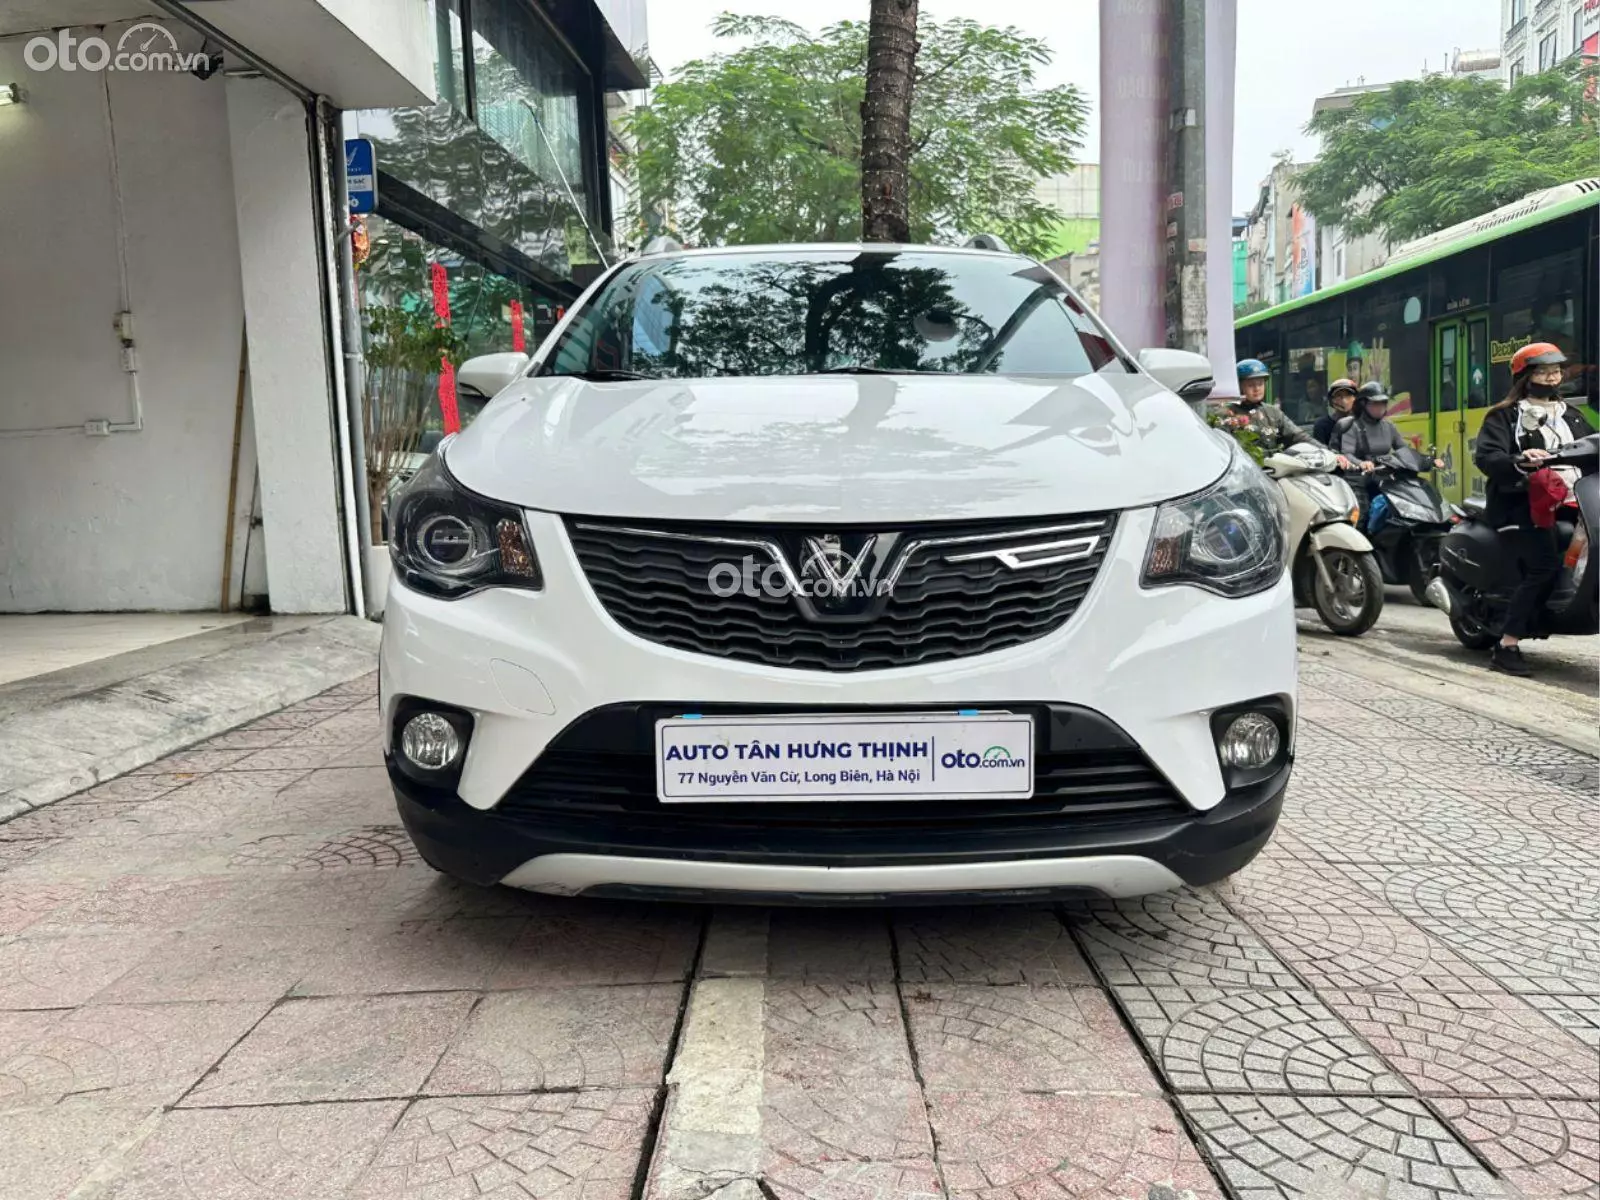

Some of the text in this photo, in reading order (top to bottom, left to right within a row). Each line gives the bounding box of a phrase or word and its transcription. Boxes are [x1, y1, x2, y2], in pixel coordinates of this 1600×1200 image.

[665, 740, 928, 762] AUTO TÂN HƯNG THỊNH
[941, 748, 1025, 769] oto.com.vn
[678, 769, 921, 786] 77 Nguyễn Văn Cừ, Long Biên, Hà Nội
